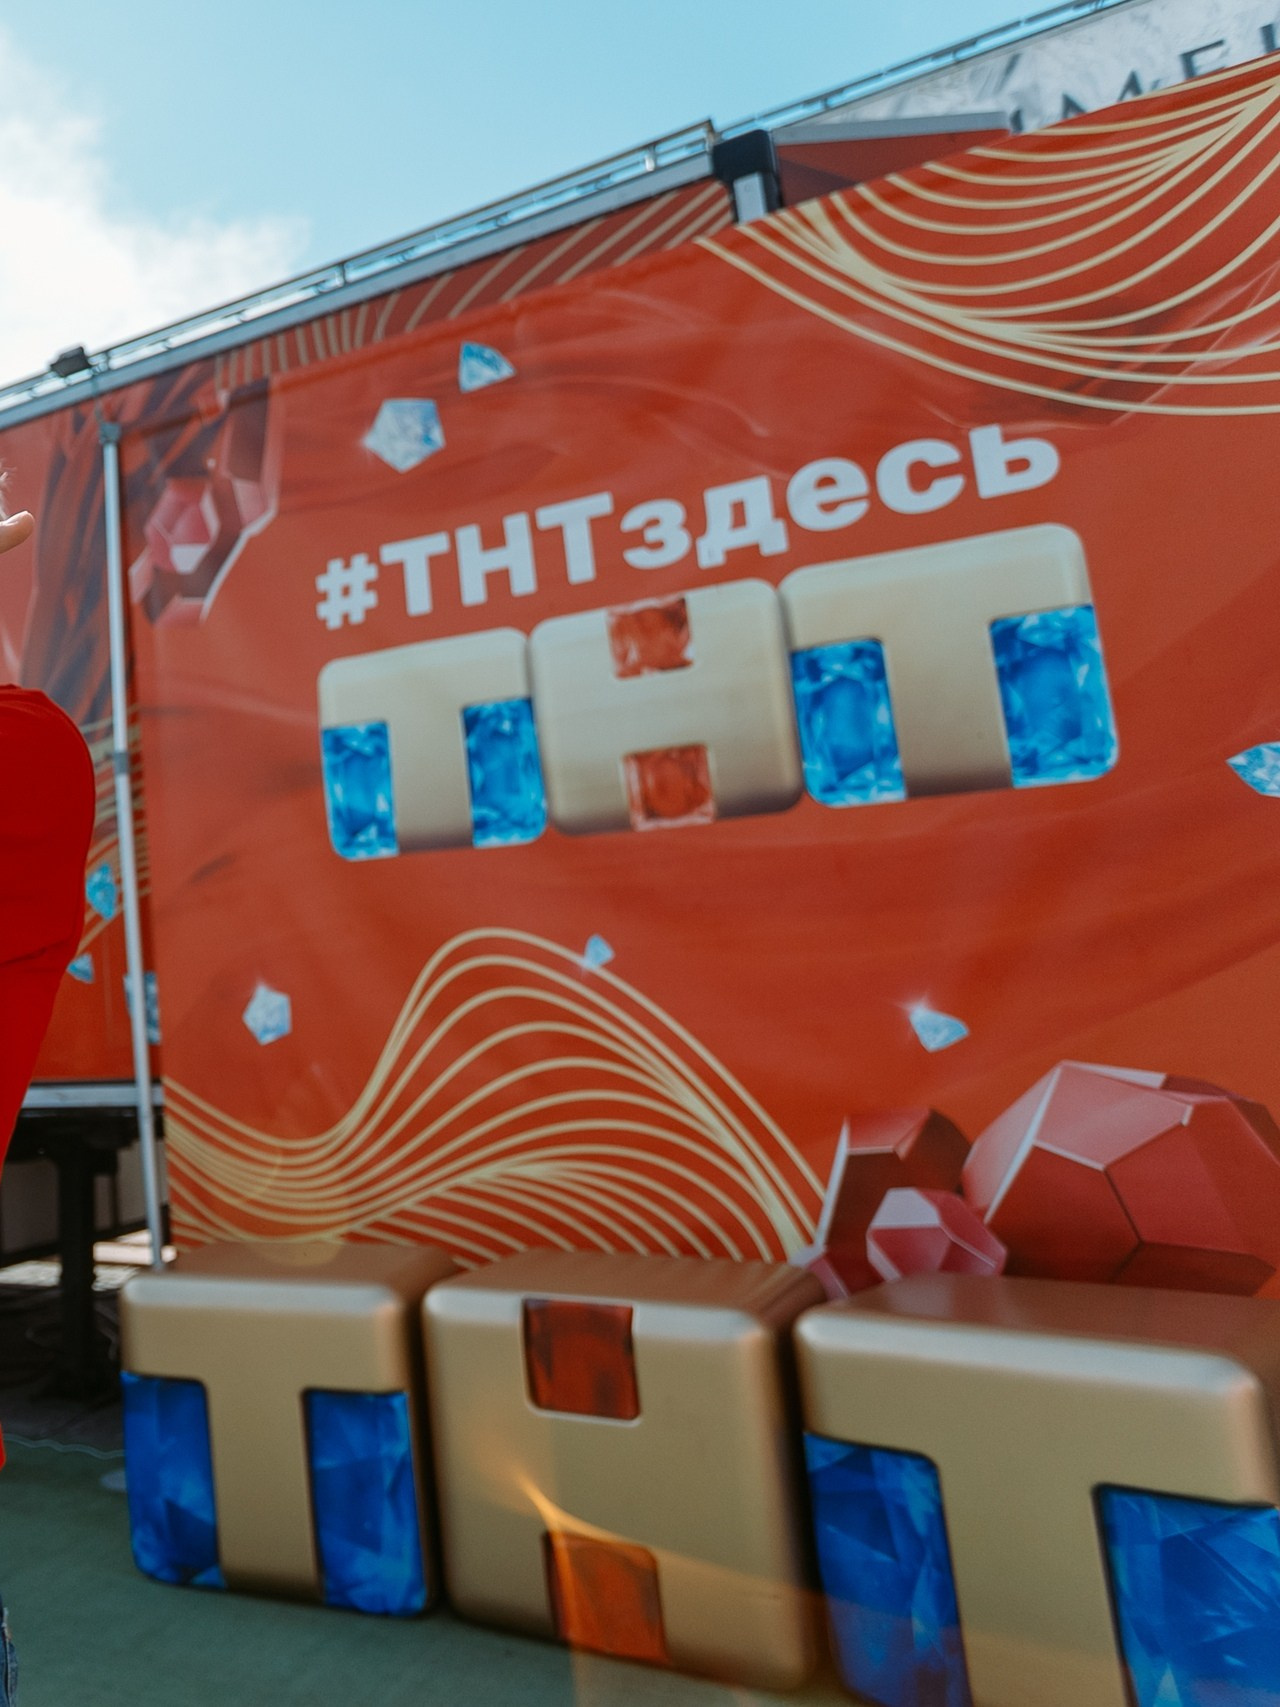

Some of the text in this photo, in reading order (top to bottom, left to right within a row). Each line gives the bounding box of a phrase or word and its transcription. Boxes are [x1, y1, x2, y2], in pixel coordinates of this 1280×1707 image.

[315, 424, 1061, 630] #ТНТздесь
[317, 522, 1120, 862] ТНТ
[120, 1270, 1280, 1707] ТНТ
